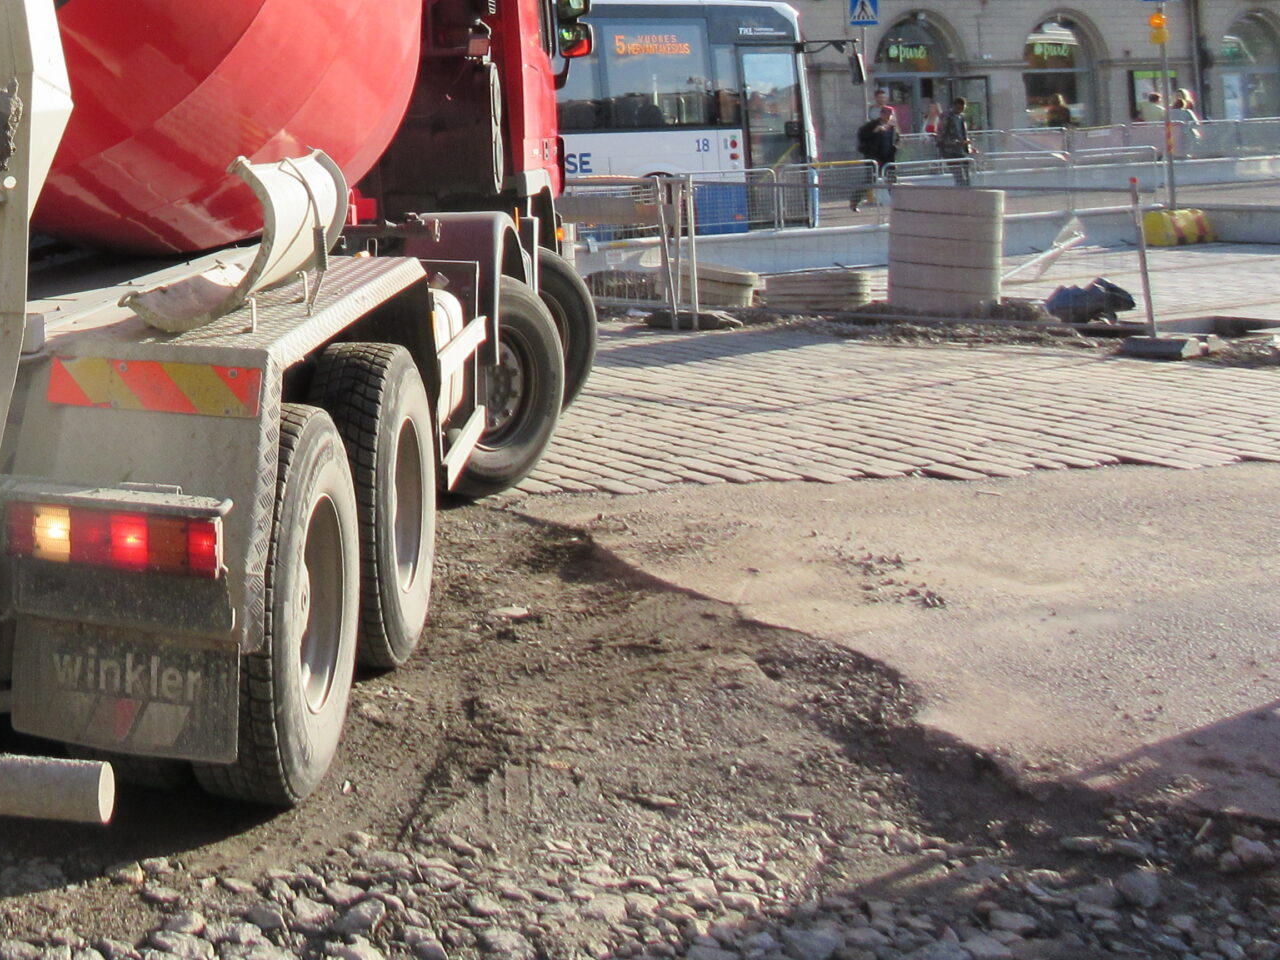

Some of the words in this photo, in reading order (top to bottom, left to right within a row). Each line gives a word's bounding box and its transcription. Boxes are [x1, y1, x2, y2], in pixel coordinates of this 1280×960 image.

[614, 35, 626, 54] 5
[899, 44, 927, 63] pure
[695, 138, 710, 152] 18
[52, 645, 204, 702] winkler
